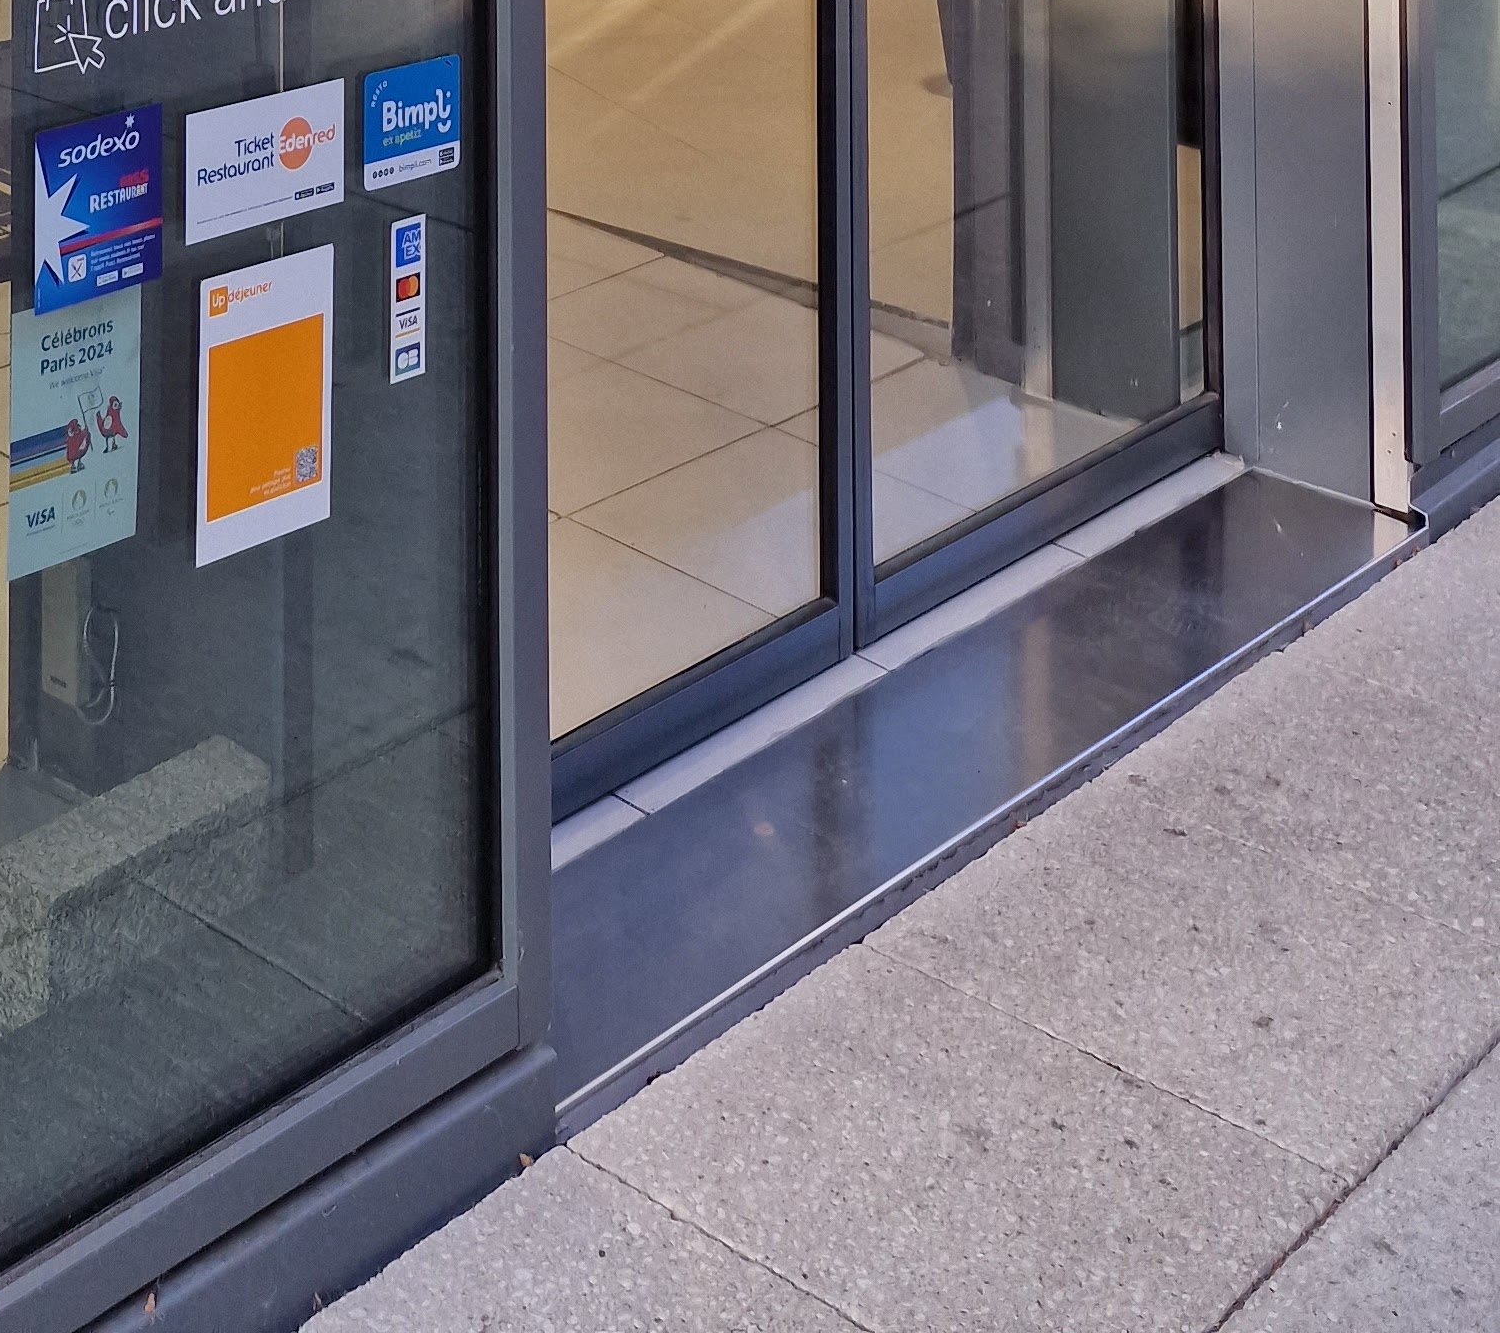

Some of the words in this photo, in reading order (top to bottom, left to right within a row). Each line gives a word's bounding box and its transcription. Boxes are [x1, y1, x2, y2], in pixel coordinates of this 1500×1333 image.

[58, 130, 140, 167] sodexo
[235, 132, 275, 157] Ticket
[279, 123, 336, 154] Edenred
[198, 151, 275, 187] Restaurant
[212, 293, 226, 308] Up
[228, 281, 272, 303] déjeuner
[41, 319, 113, 353] Célébrons
[399, 315, 417, 329] VISA
[40, 352, 75, 376] Paris
[79, 339, 113, 364] 2024
[26, 506, 55, 528] VISA
